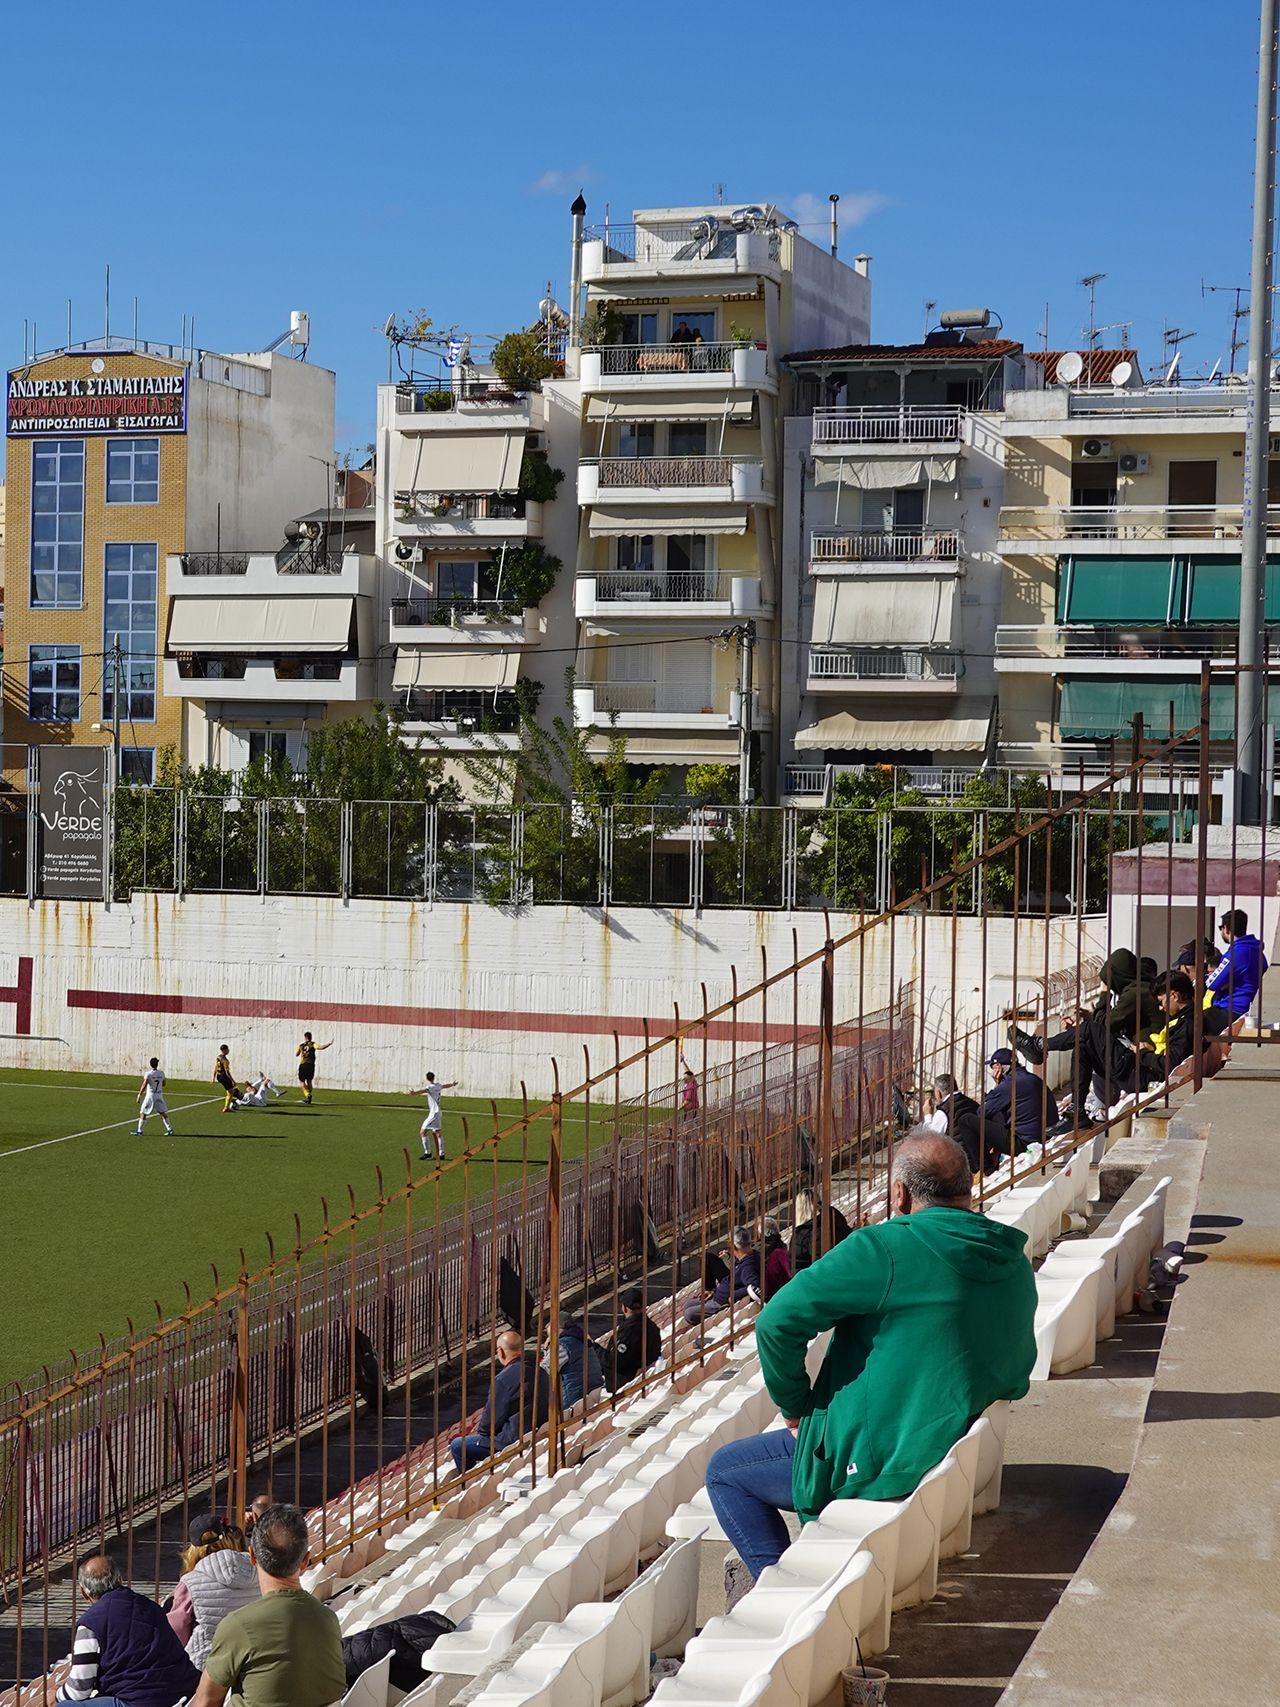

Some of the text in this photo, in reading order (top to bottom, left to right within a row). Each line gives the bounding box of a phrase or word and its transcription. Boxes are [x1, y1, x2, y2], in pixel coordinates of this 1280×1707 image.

[9, 376, 183, 398] ΑΝΔΡΕΑΣ Κ. ΣΤΑΜΑΤΙΑΔΗΣ
[8, 396, 148, 417] ΧΡΩΜΑΤΟΣΙΔΗΡΙΚΗ
[11, 415, 178, 430] ΑΝΤΙΠΡΟΣΩΠΕΙΑΙ ΕΙΣΑΓΩΓΑΙ
[40, 810, 102, 831] VERDE
[62, 831, 102, 841] papagalo
